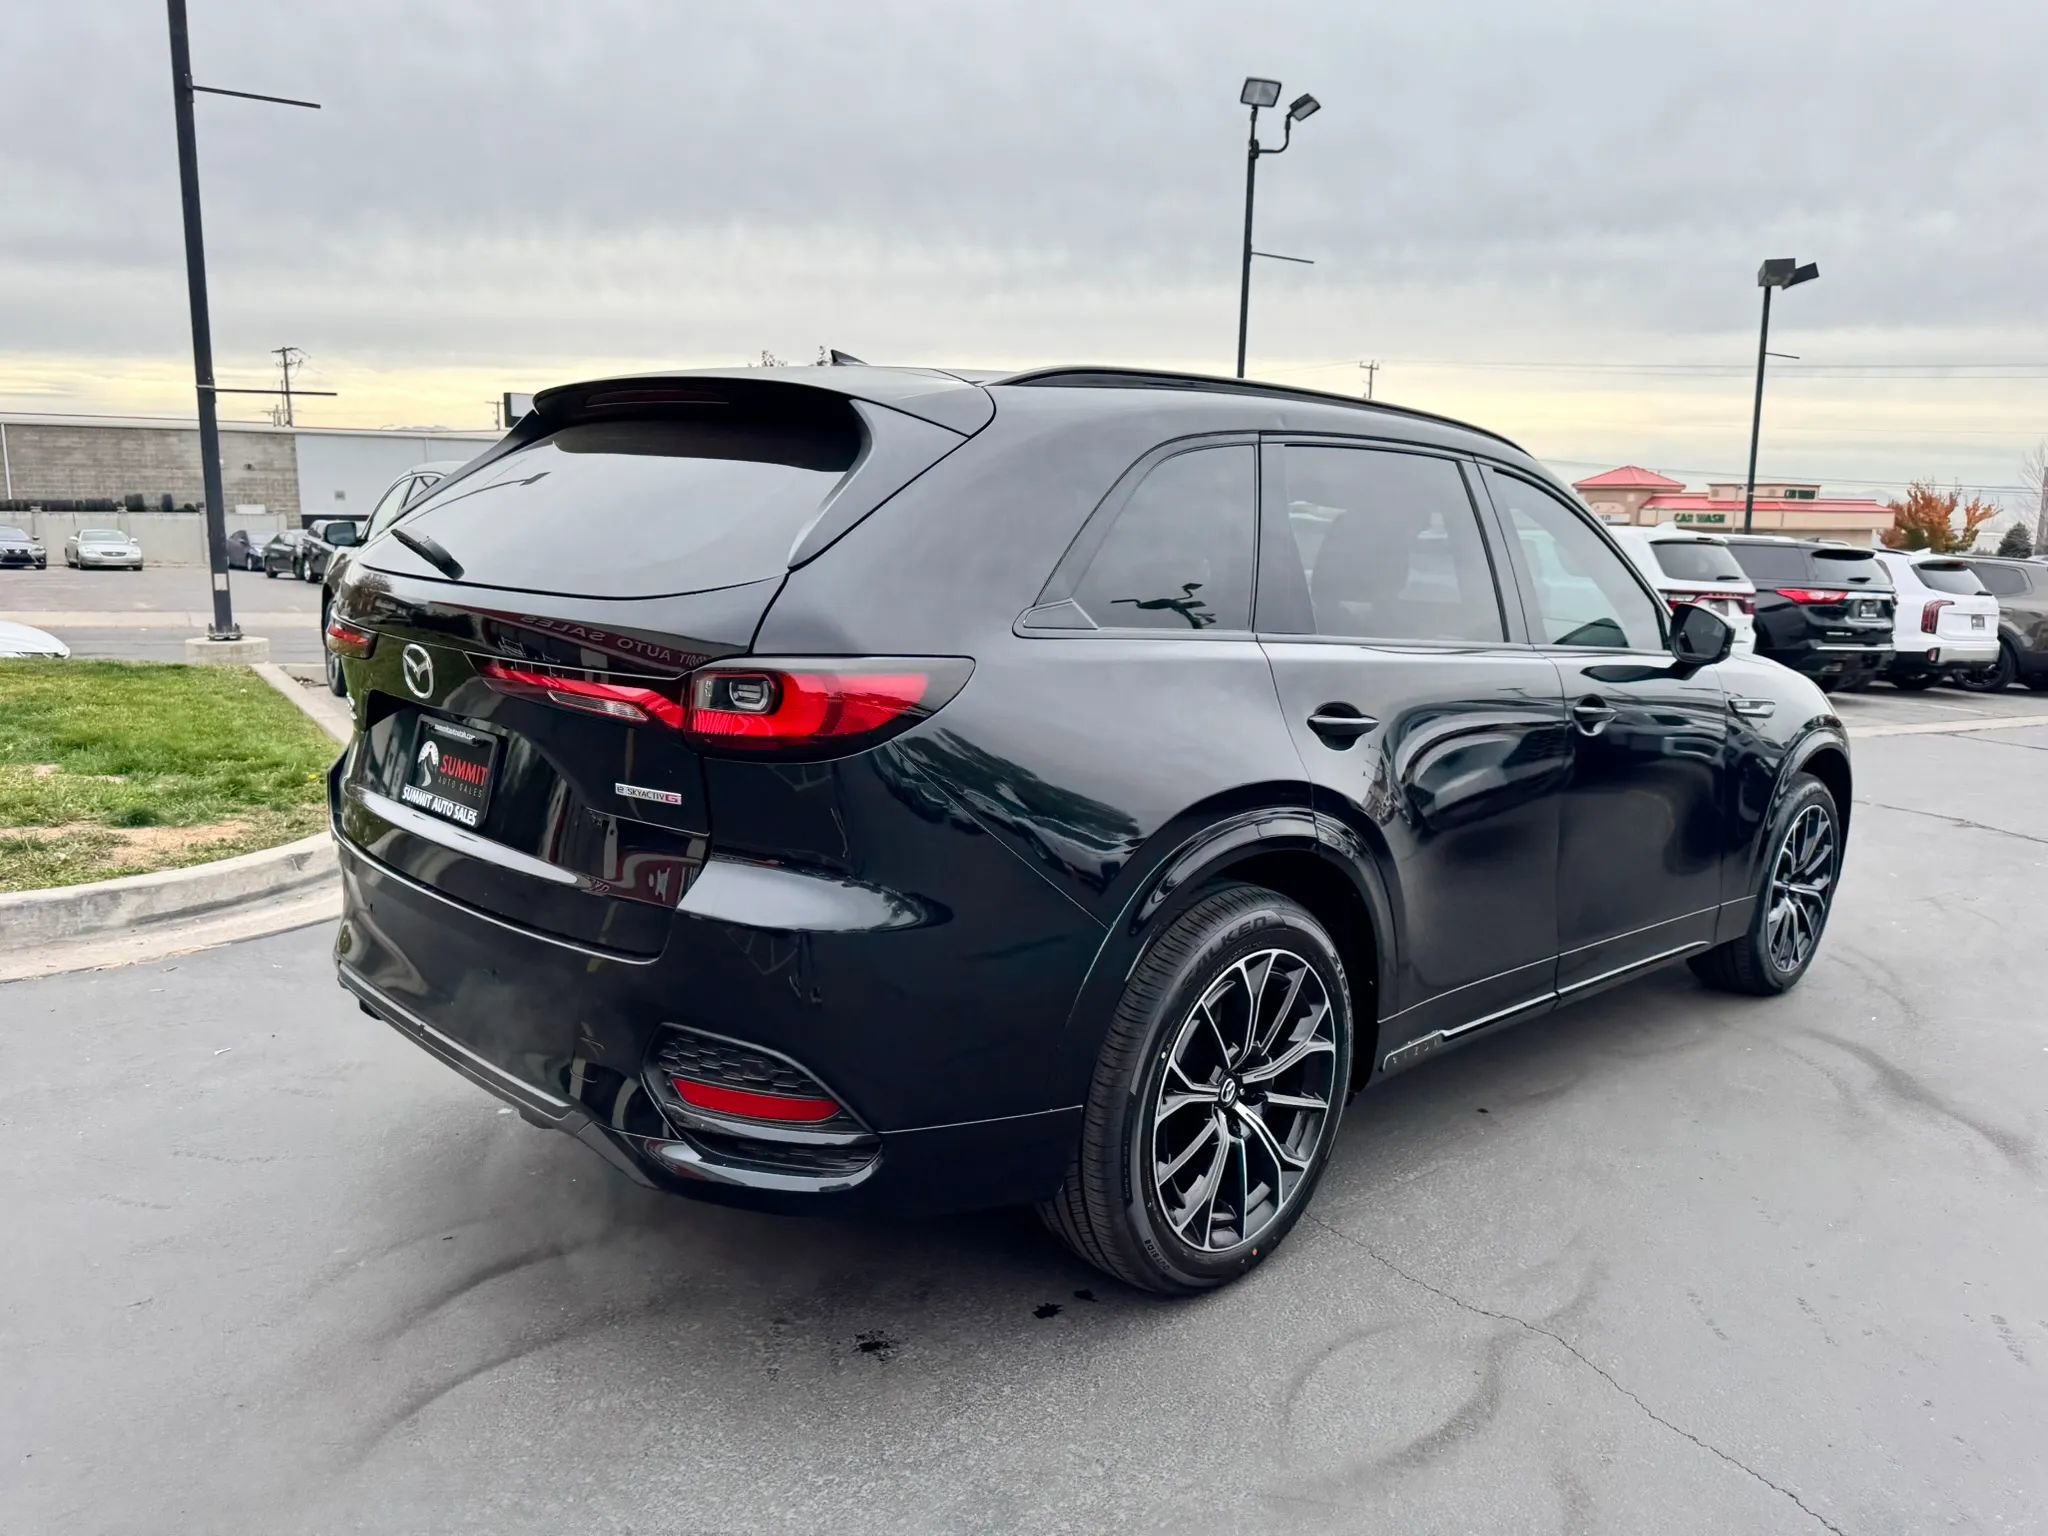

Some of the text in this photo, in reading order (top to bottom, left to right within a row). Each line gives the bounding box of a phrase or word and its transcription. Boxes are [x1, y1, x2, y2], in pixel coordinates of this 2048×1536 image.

[1674, 512, 1726, 524] CAR WASH
[440, 754, 489, 786] SUMMIT
[438, 776, 483, 798] AUTO SALES
[402, 786, 478, 826] SUMMIT AUTO SALES
